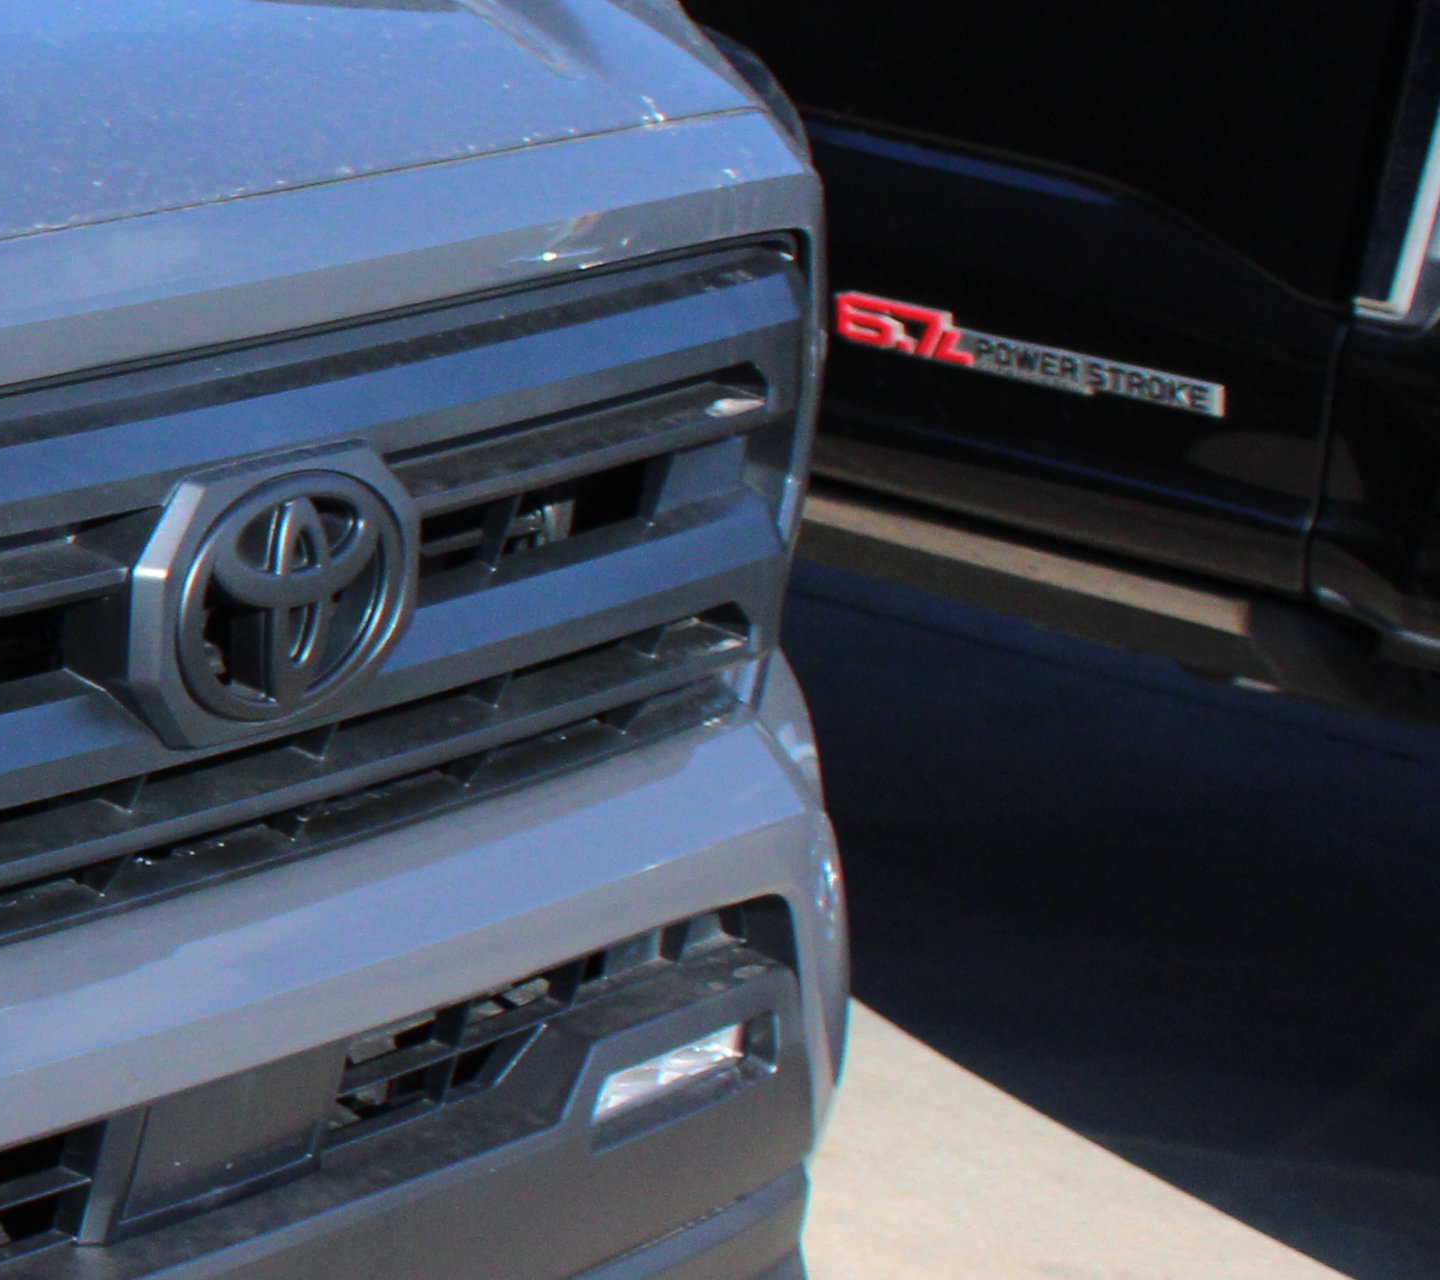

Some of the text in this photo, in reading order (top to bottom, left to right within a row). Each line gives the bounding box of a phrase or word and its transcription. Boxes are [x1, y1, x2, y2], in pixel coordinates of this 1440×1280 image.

[835, 290, 975, 366] 6.7L
[973, 338, 1080, 382] POWER
[1088, 361, 1210, 412] STROKE
